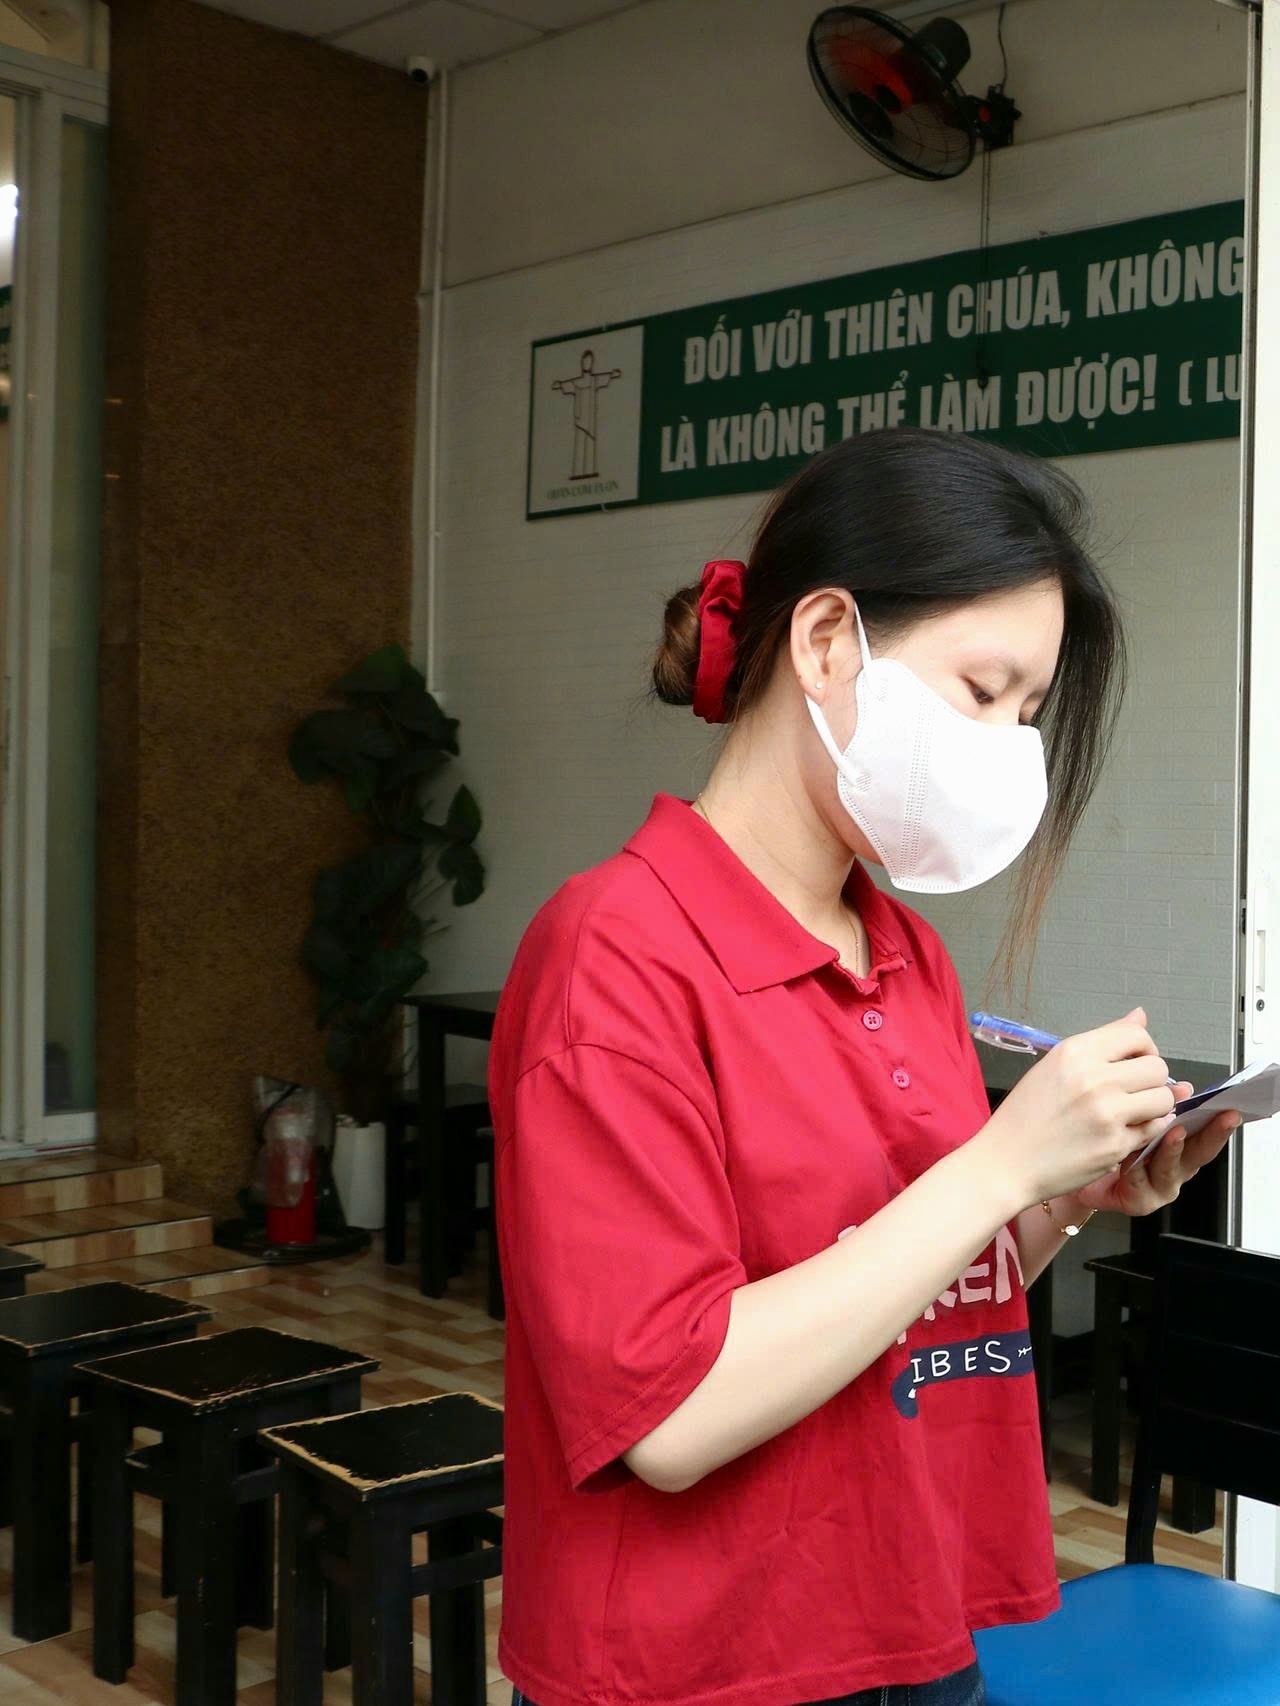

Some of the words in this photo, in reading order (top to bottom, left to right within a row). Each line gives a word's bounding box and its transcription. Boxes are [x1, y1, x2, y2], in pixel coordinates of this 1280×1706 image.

[684, 314, 742, 385] ĐỐI
[752, 308, 814, 373] VỚI
[824, 288, 934, 360] THIÊN
[946, 265, 1071, 339] CHÚA,
[1086, 236, 1245, 319] KHÔNG
[660, 415, 697, 472] LÀ
[706, 402, 826, 467] KHÔNG
[919, 373, 1002, 434] LÀM
[1015, 352, 1158, 430] ĐƯỢC!
[1206, 353, 1243, 403] LU
[908, 1340, 1011, 1398] IBES
